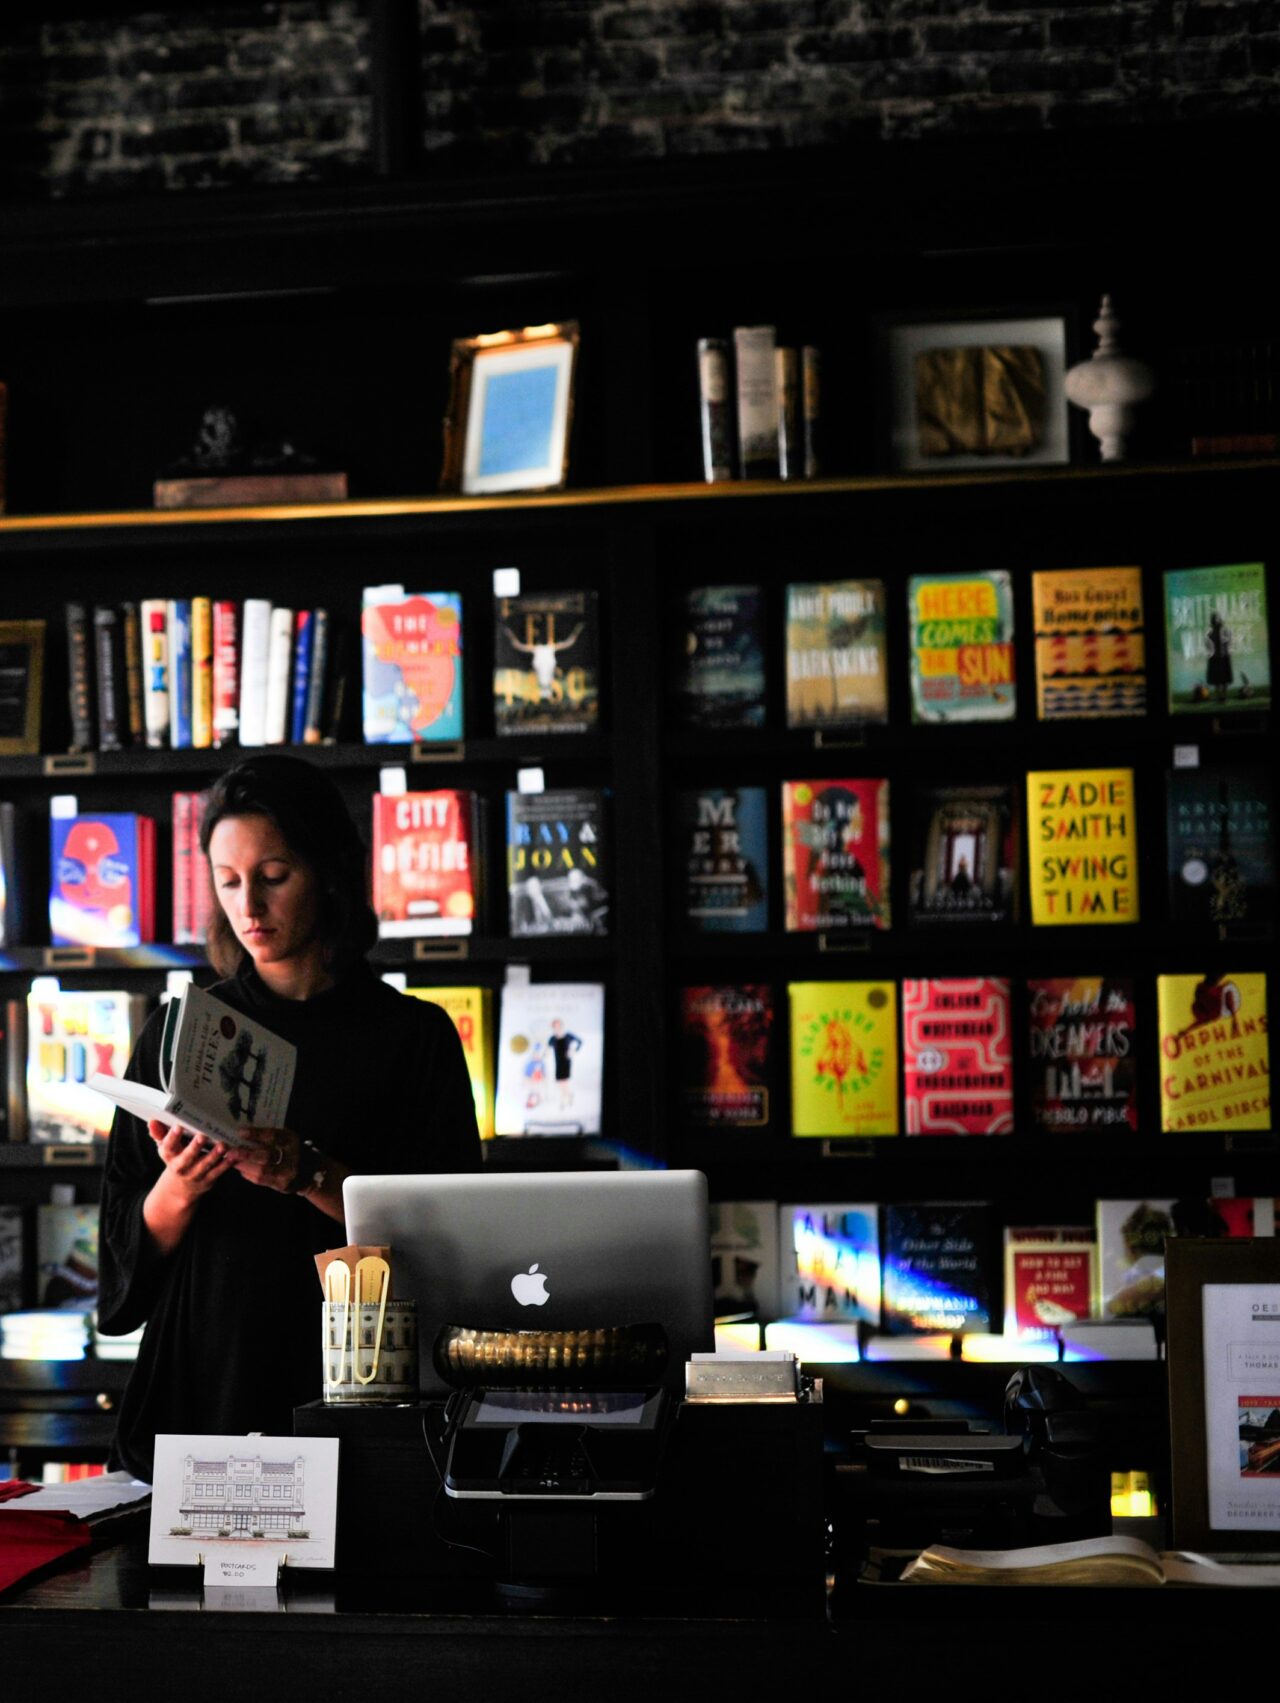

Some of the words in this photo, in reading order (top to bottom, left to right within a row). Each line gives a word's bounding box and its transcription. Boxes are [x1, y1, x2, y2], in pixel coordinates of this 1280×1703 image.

[923, 584, 992, 617] HERE
[923, 621, 992, 646] COMES
[963, 648, 1012, 685] SUN
[1039, 781, 1126, 808] ZADIE
[396, 799, 449, 831] CITY
[697, 797, 736, 827] M
[1041, 813, 1128, 841] SMITH
[511, 846, 597, 872] JOAN
[1043, 854, 1128, 882] SWING
[1042, 887, 1130, 915] TIME
[1029, 1020, 1131, 1060] DREAMERS
[1163, 1014, 1268, 1060] ORPHANS
[201, 1028, 222, 1086] TREES
[1216, 1044, 1244, 1061] THE
[1165, 1058, 1270, 1100] CARNIVAL
[934, 1103, 994, 1117] RAILROAD
[1166, 1108, 1218, 1131] CAROL
[800, 1284, 860, 1309] MAN
[1244, 1361, 1279, 1369] THOMAS
[220, 1562, 257, 1571] POSTCARDS
